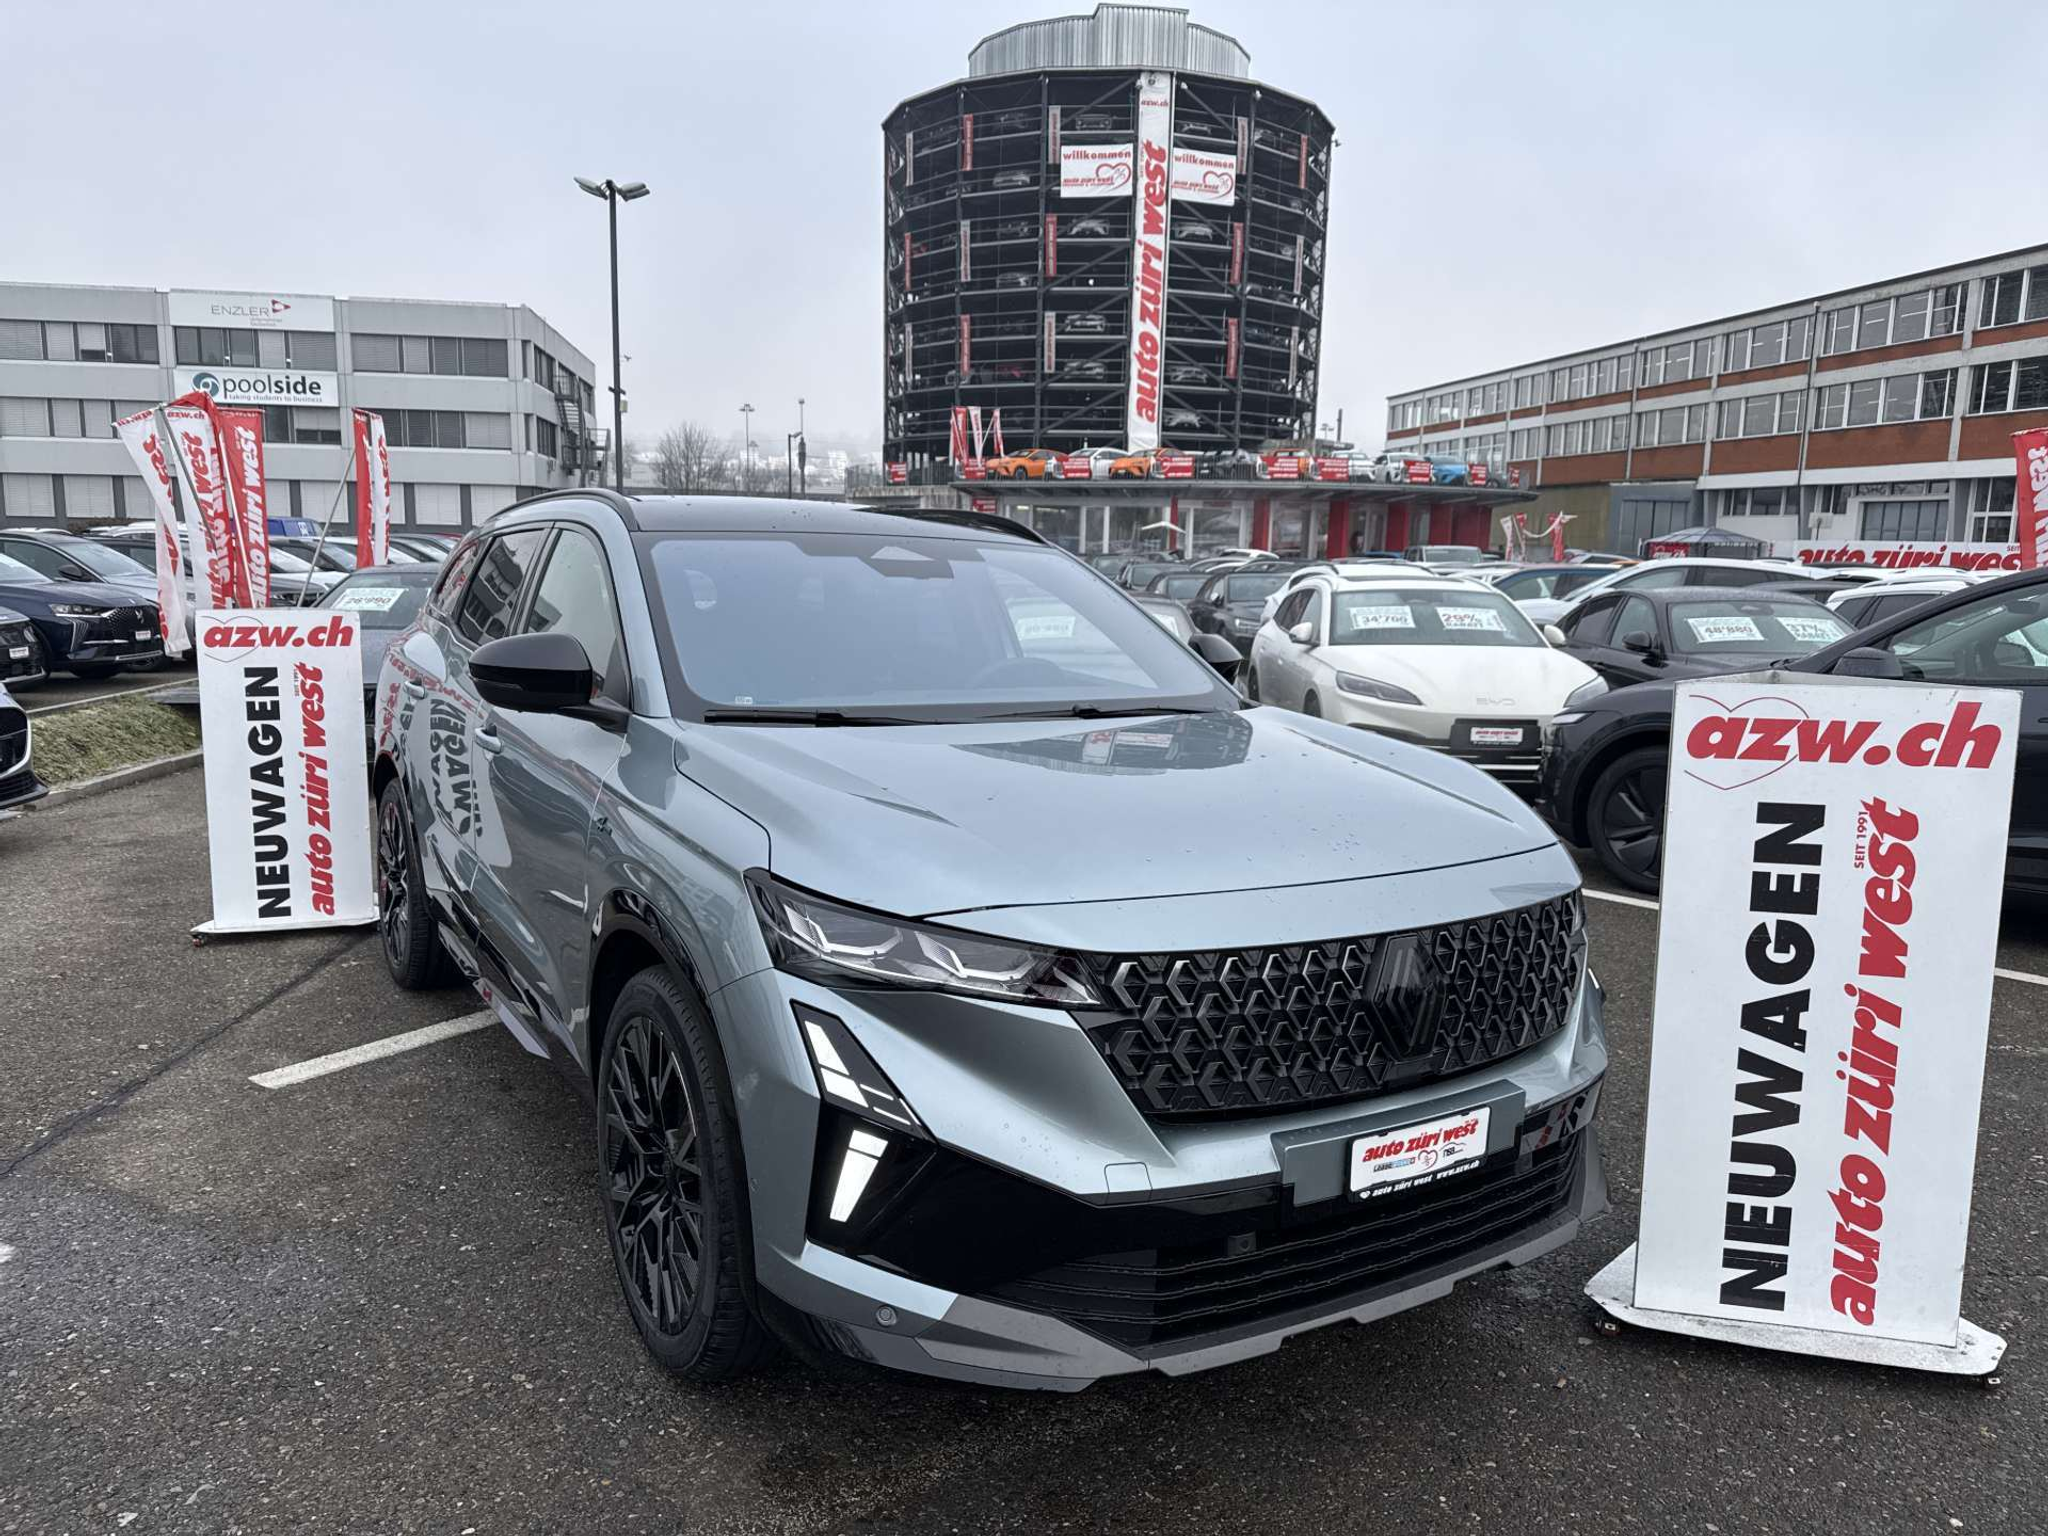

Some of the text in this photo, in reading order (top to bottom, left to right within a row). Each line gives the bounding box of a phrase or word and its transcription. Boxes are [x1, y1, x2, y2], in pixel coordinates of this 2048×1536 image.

[1063, 150, 1131, 160] willkommen
[1174, 153, 1235, 169] willkommen
[211, 305, 269, 317] ENZLER
[1134, 138, 1167, 423] auto züri west
[223, 374, 322, 400] poolside
[181, 430, 209, 493] west
[235, 426, 259, 488] west
[241, 485, 264, 549] züri
[1797, 540, 1866, 566] auto
[1871, 544, 1948, 569] züri
[203, 615, 354, 648] azw.ch
[1686, 700, 2003, 770] azw.ch
[244, 666, 292, 919] NEUWAGEN
[293, 661, 336, 916] auto züri west
[1854, 809, 1869, 870] SEIT 1991
[1720, 801, 1826, 1312] NEUWAGEN
[1827, 796, 1920, 1327] auto züri west
[1362, 1119, 1479, 1163] auto züri west
[1372, 1185, 1392, 1197] auto
[1393, 1180, 1413, 1192] züri
[1414, 1175, 1433, 1186] west
